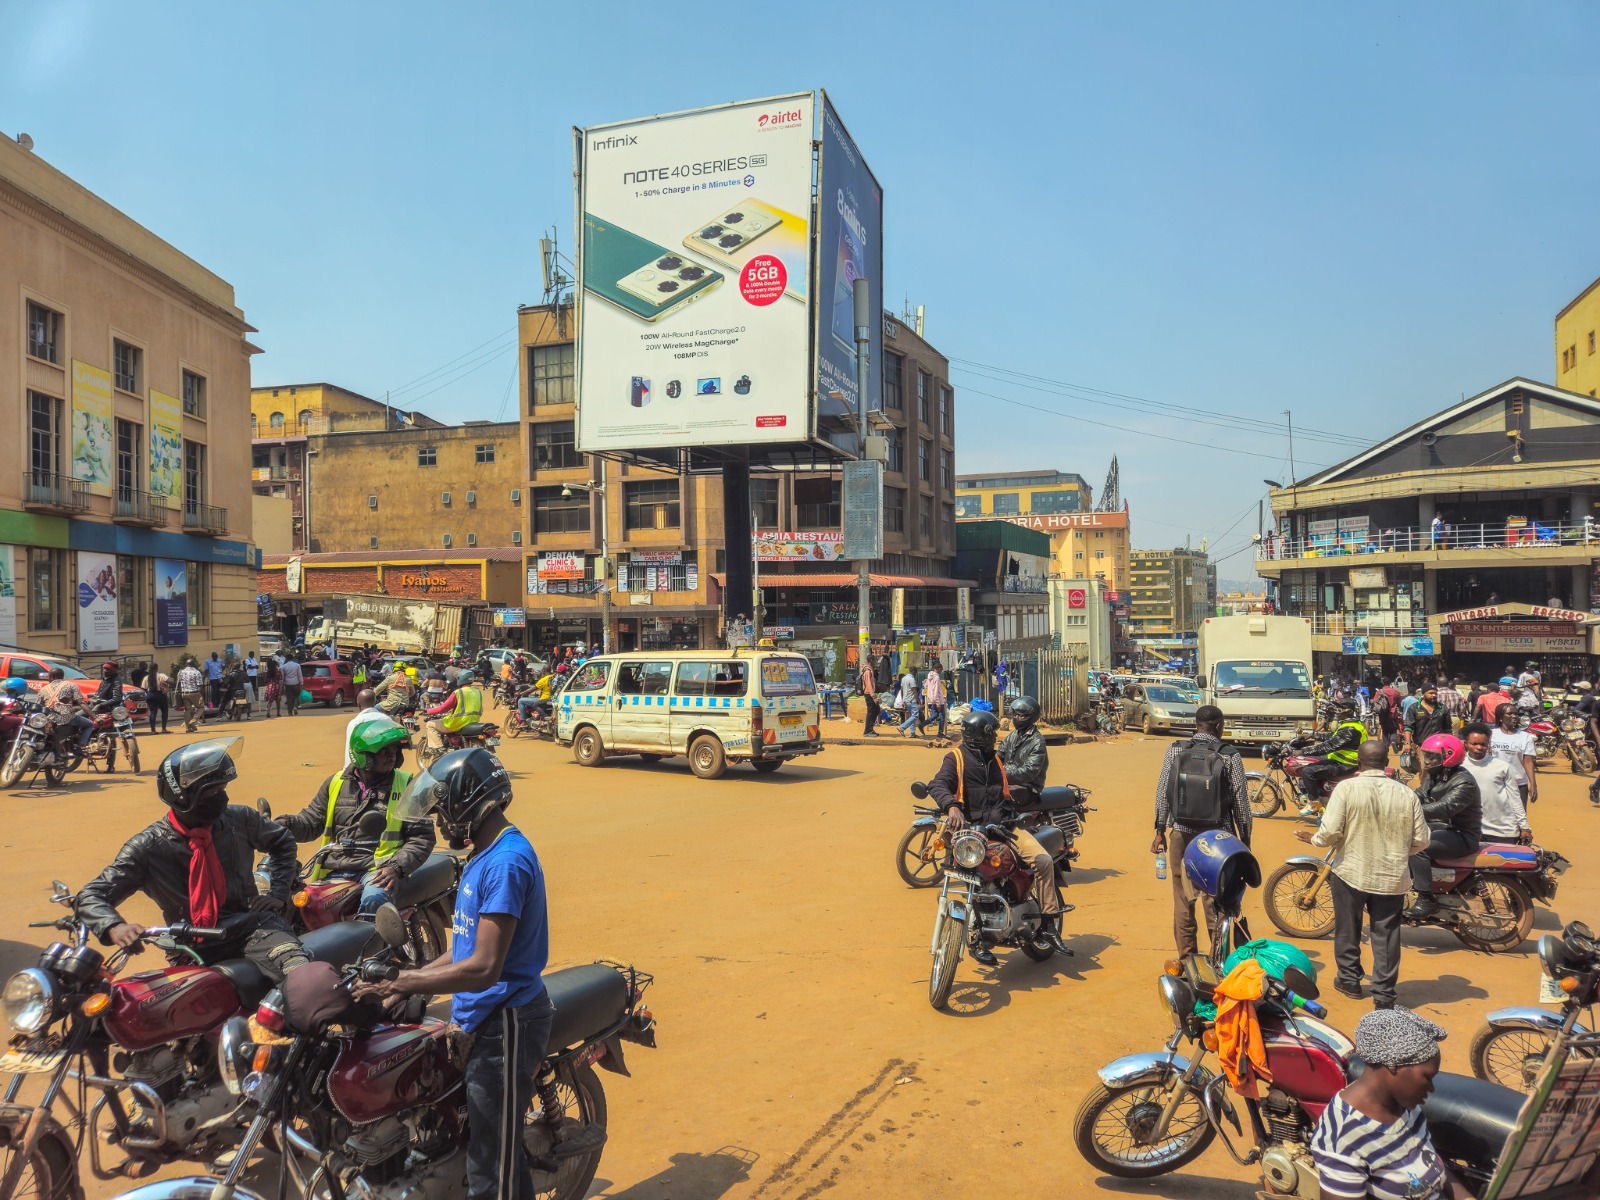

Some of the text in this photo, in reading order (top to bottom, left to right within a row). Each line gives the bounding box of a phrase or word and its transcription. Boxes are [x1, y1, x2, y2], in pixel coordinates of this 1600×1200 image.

[770, 109, 803, 125] airtel
[593, 134, 638, 151] Infinix
[623, 167, 670, 184] NOTE
[670, 164, 690, 178] 40
[692, 156, 748, 176] SERIES
[662, 184, 691, 195] Charge
[692, 183, 700, 191] in
[701, 182, 707, 190] 8
[708, 178, 741, 189] Minutes
[837, 188, 867, 246] 8mins
[747, 266, 779, 281] 5GB
[661, 331, 694, 339] All-Round
[695, 325, 746, 336] FastCharge2.0
[662, 342, 693, 350] Wireless
[673, 351, 697, 360] 108MP
[1048, 515, 1102, 527] HOTEL
[545, 551, 577, 559] DENTAL
[401, 574, 447, 586] Ivanos
[355, 602, 401, 614] GOLD STAR
[831, 602, 874, 611] SALAA
[829, 611, 877, 620] RESTAUNT
[1545, 638, 1580, 646] HYBRID
[138, 981, 182, 1009] BOXER
[367, 1045, 413, 1079] BOXER
